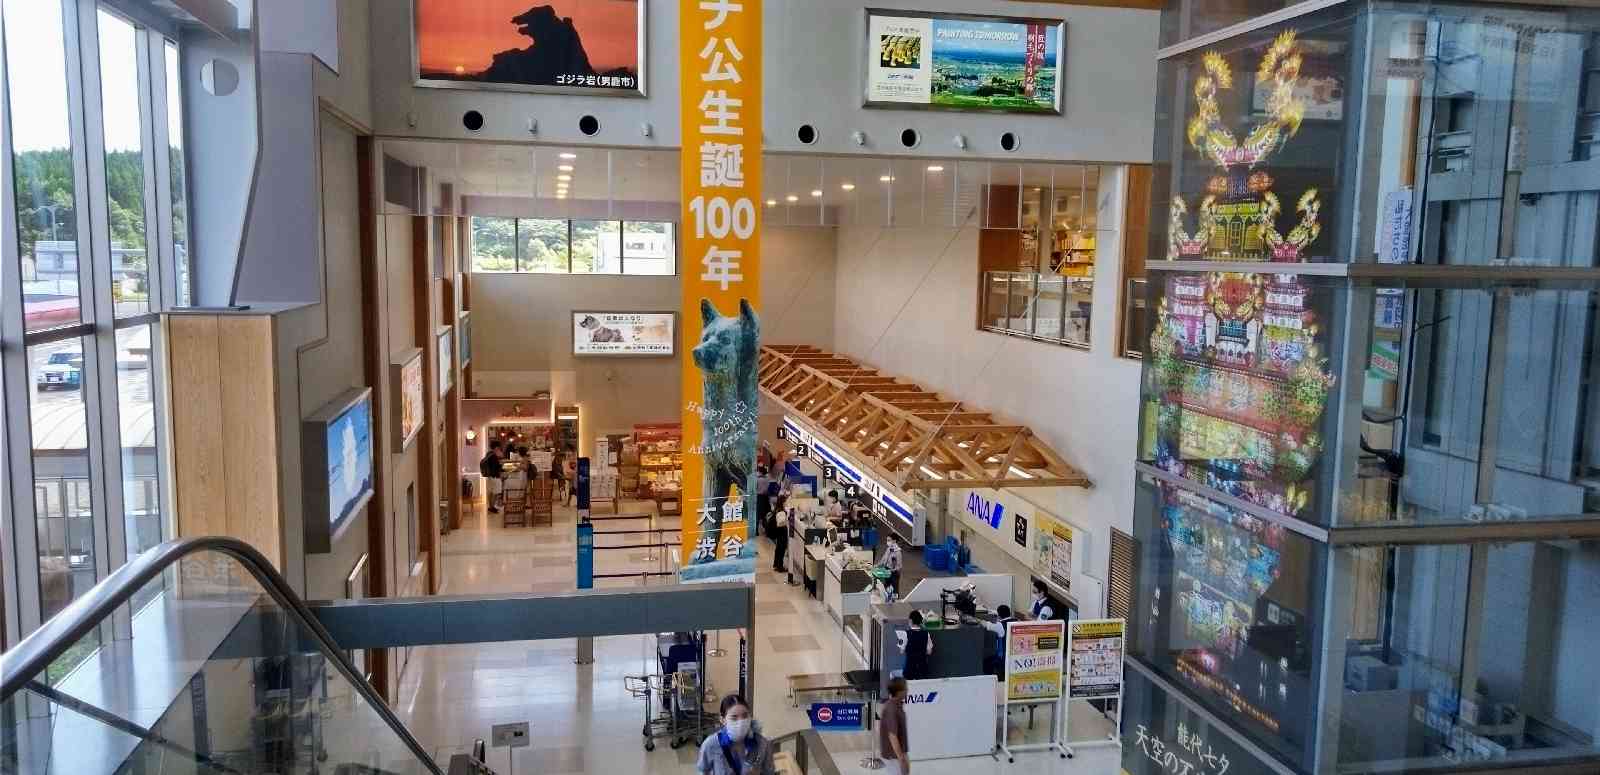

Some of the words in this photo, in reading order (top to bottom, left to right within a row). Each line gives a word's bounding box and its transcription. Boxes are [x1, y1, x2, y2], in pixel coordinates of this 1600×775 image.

[687, 400, 725, 421] Happy
[713, 415, 743, 437] 100th
[779, 429, 785, 438] 1
[798, 445, 804, 455] 2
[825, 467, 832, 478] 3
[847, 486, 856, 497] 4
[696, 500, 744, 526] 大館
[966, 491, 992, 525] ANA
[696, 534, 745, 561] 渋谷
